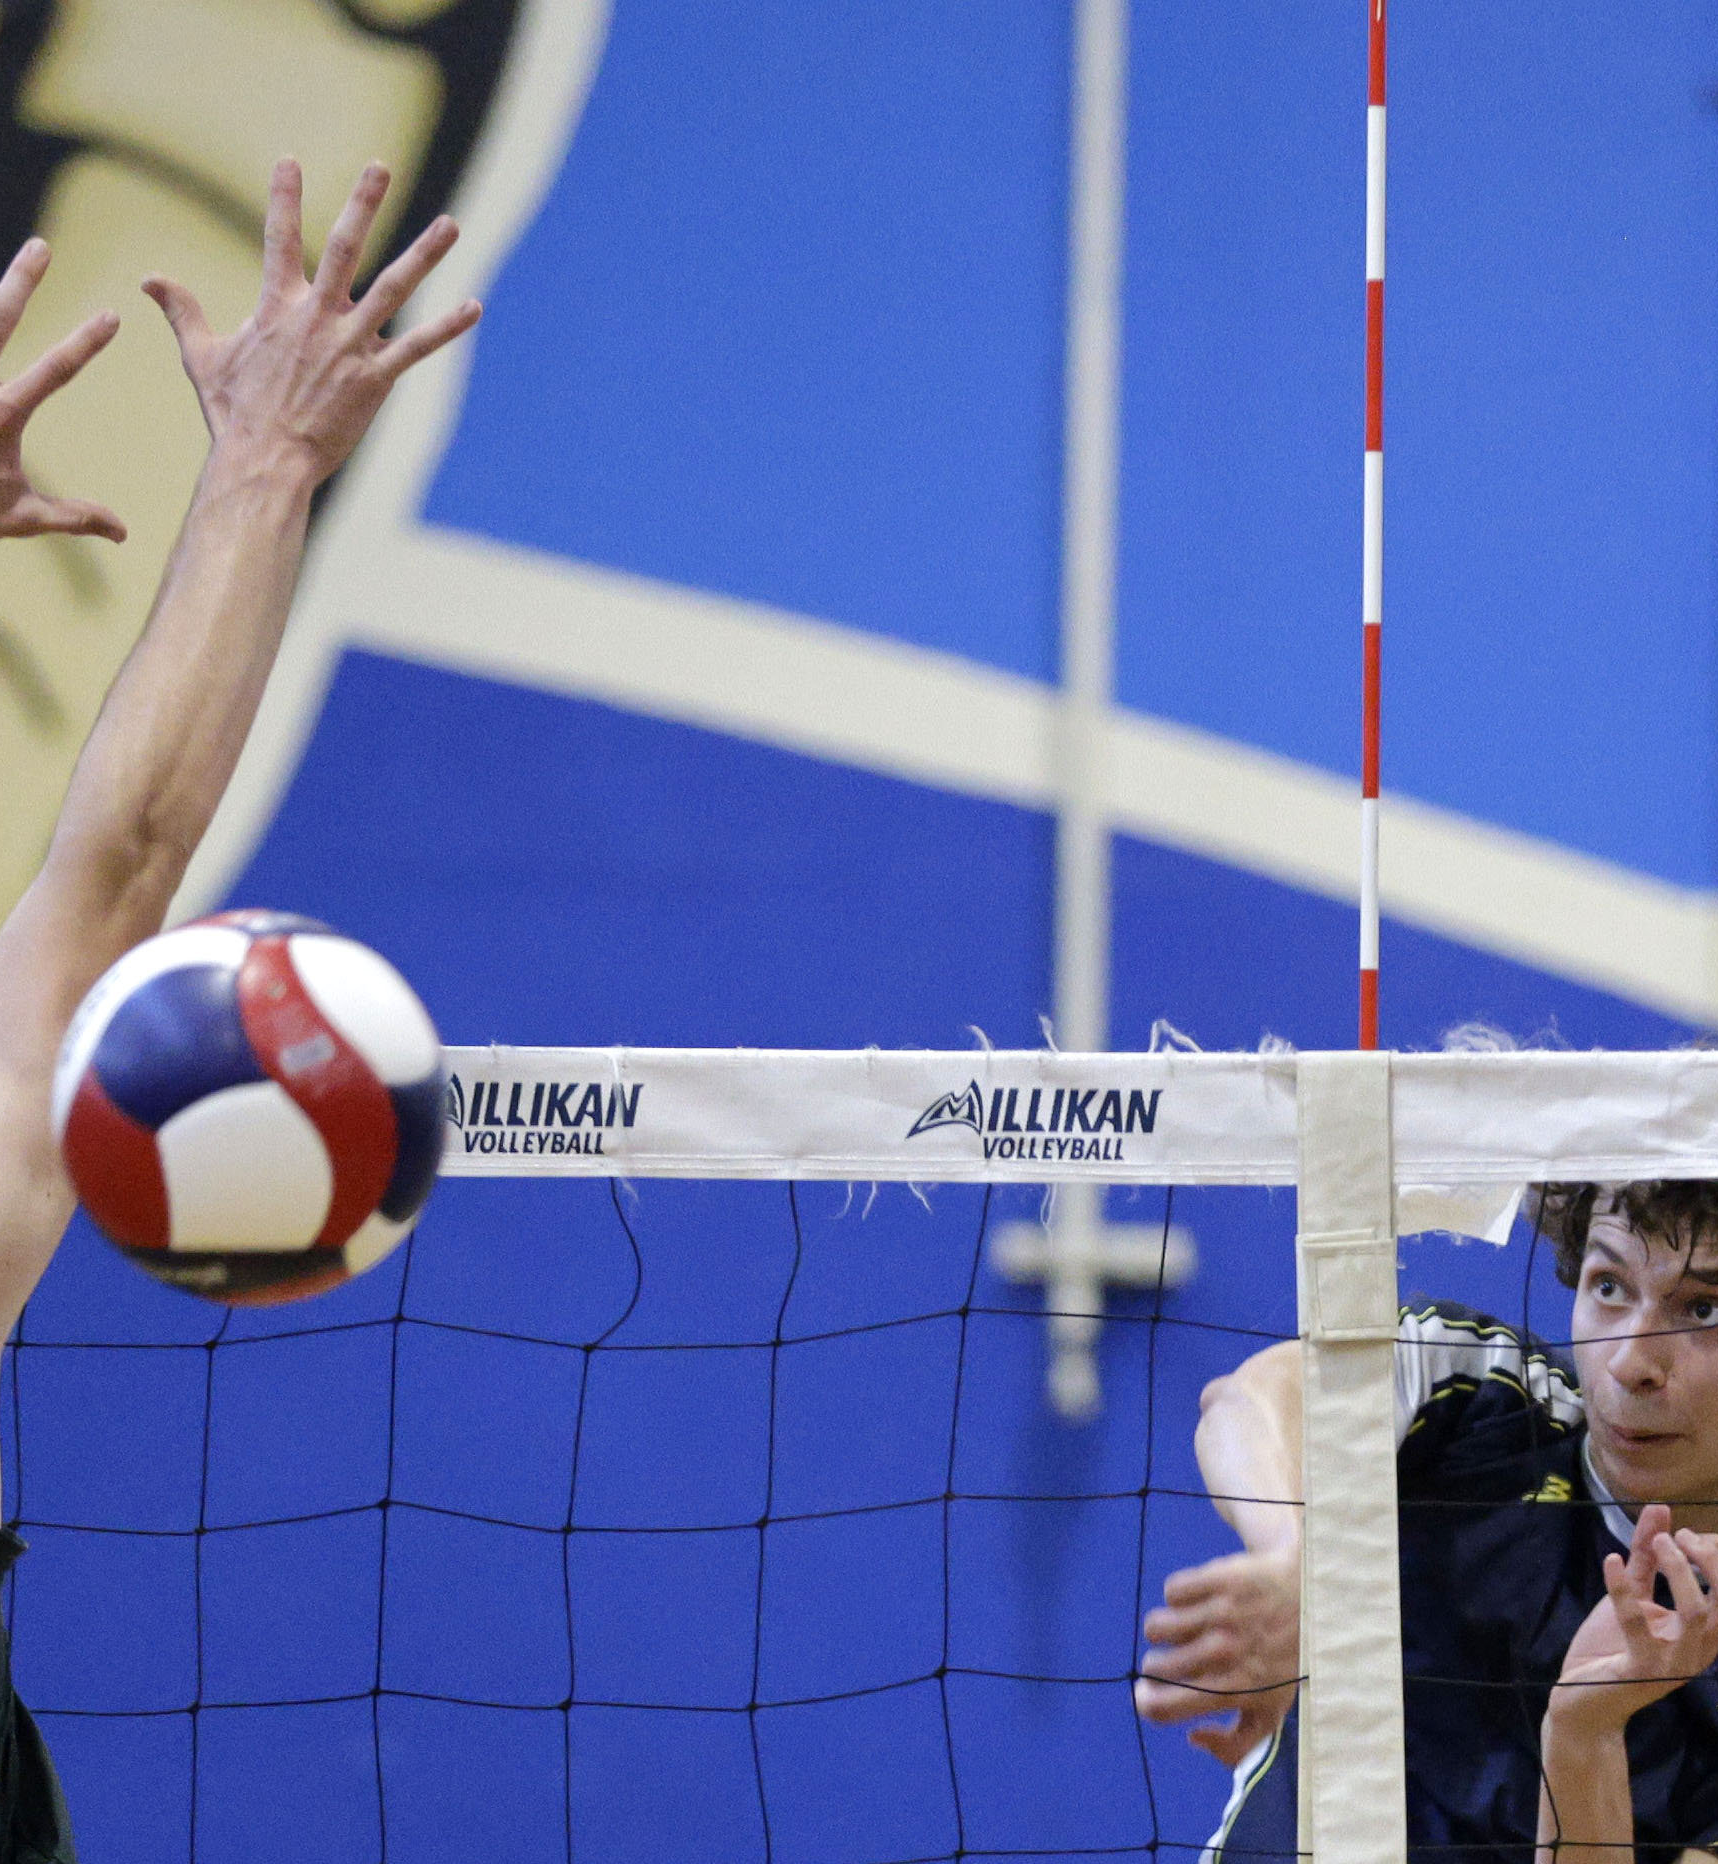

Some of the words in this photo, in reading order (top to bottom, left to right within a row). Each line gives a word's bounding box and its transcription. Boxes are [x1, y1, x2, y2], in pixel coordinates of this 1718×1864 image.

[445, 1073, 644, 1129] ILLIKAN
[905, 1079, 1163, 1138] MILLIKAN
[464, 1131, 605, 1155] VOLLEYBALL
[983, 1136, 1125, 1161] VOLLEYBALL
